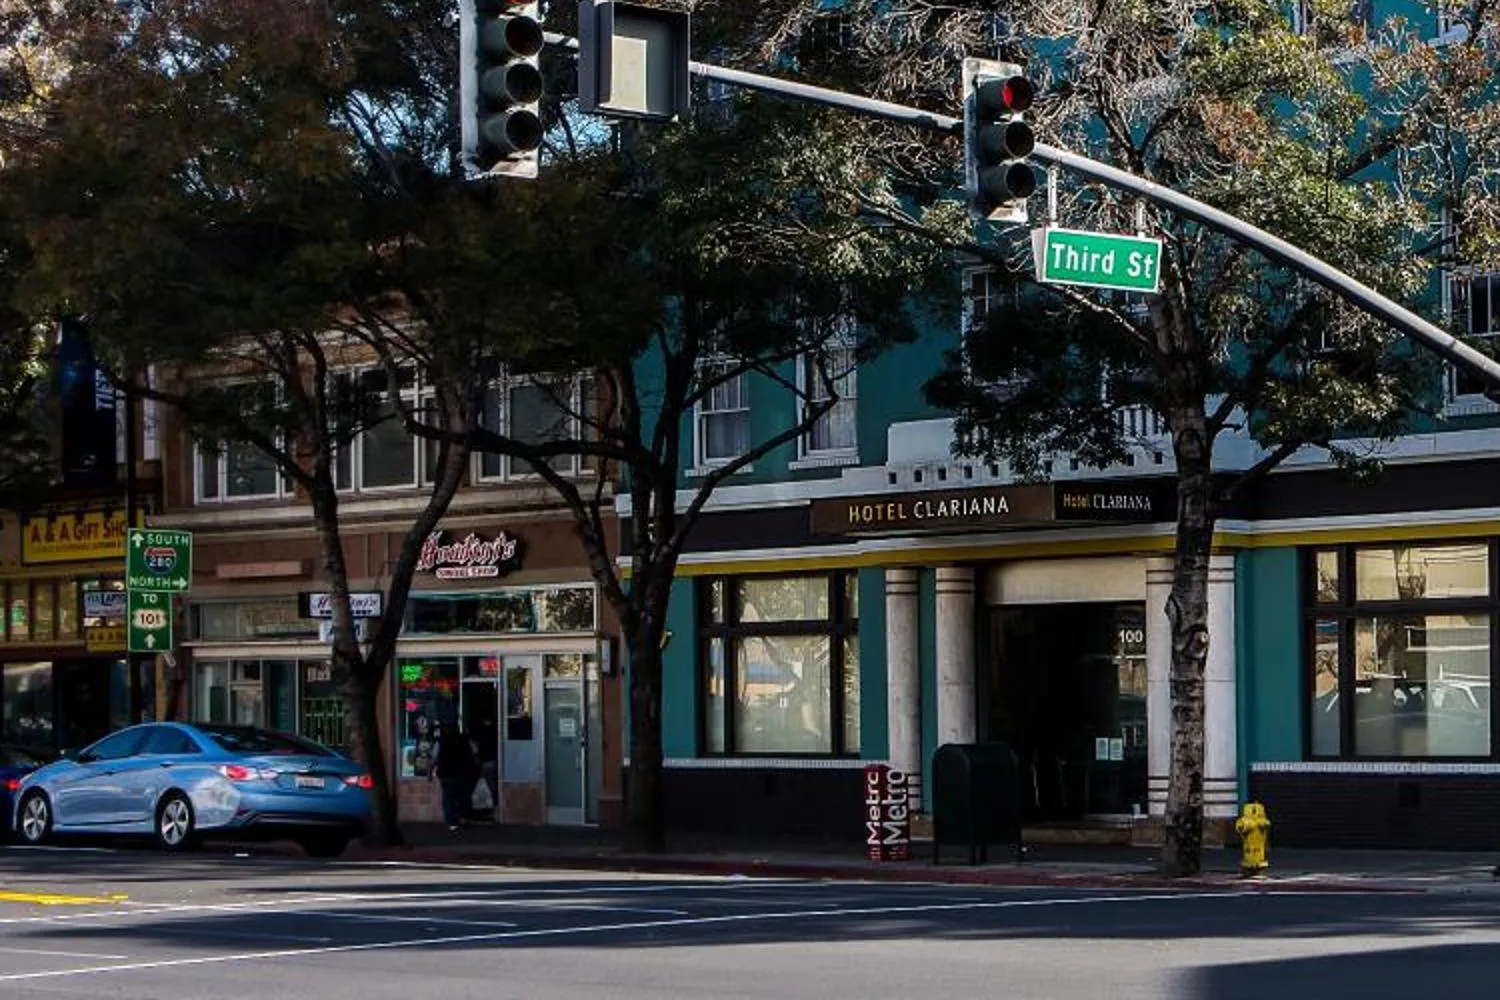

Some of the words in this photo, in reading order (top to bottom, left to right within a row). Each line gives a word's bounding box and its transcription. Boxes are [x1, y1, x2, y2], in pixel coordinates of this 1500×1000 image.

[1051, 243, 1114, 275] Third
[1127, 251, 1154, 279] St
[849, 503, 906, 523] HOTEL
[913, 496, 1009, 519] CLARIANA
[1093, 494, 1151, 511] CLARIANA
[31, 525, 41, 542] A
[59, 521, 69, 541] A
[103, 519, 127, 538] SHO
[147, 533, 189, 546] SOUTH
[149, 555, 173, 567] 280
[129, 576, 171, 588] NORTH
[141, 594, 158, 604] TO
[140, 613, 161, 625] 101
[1119, 629, 1143, 643] 100
[865, 771, 881, 845] Metro
[881, 769, 908, 845] Metro
